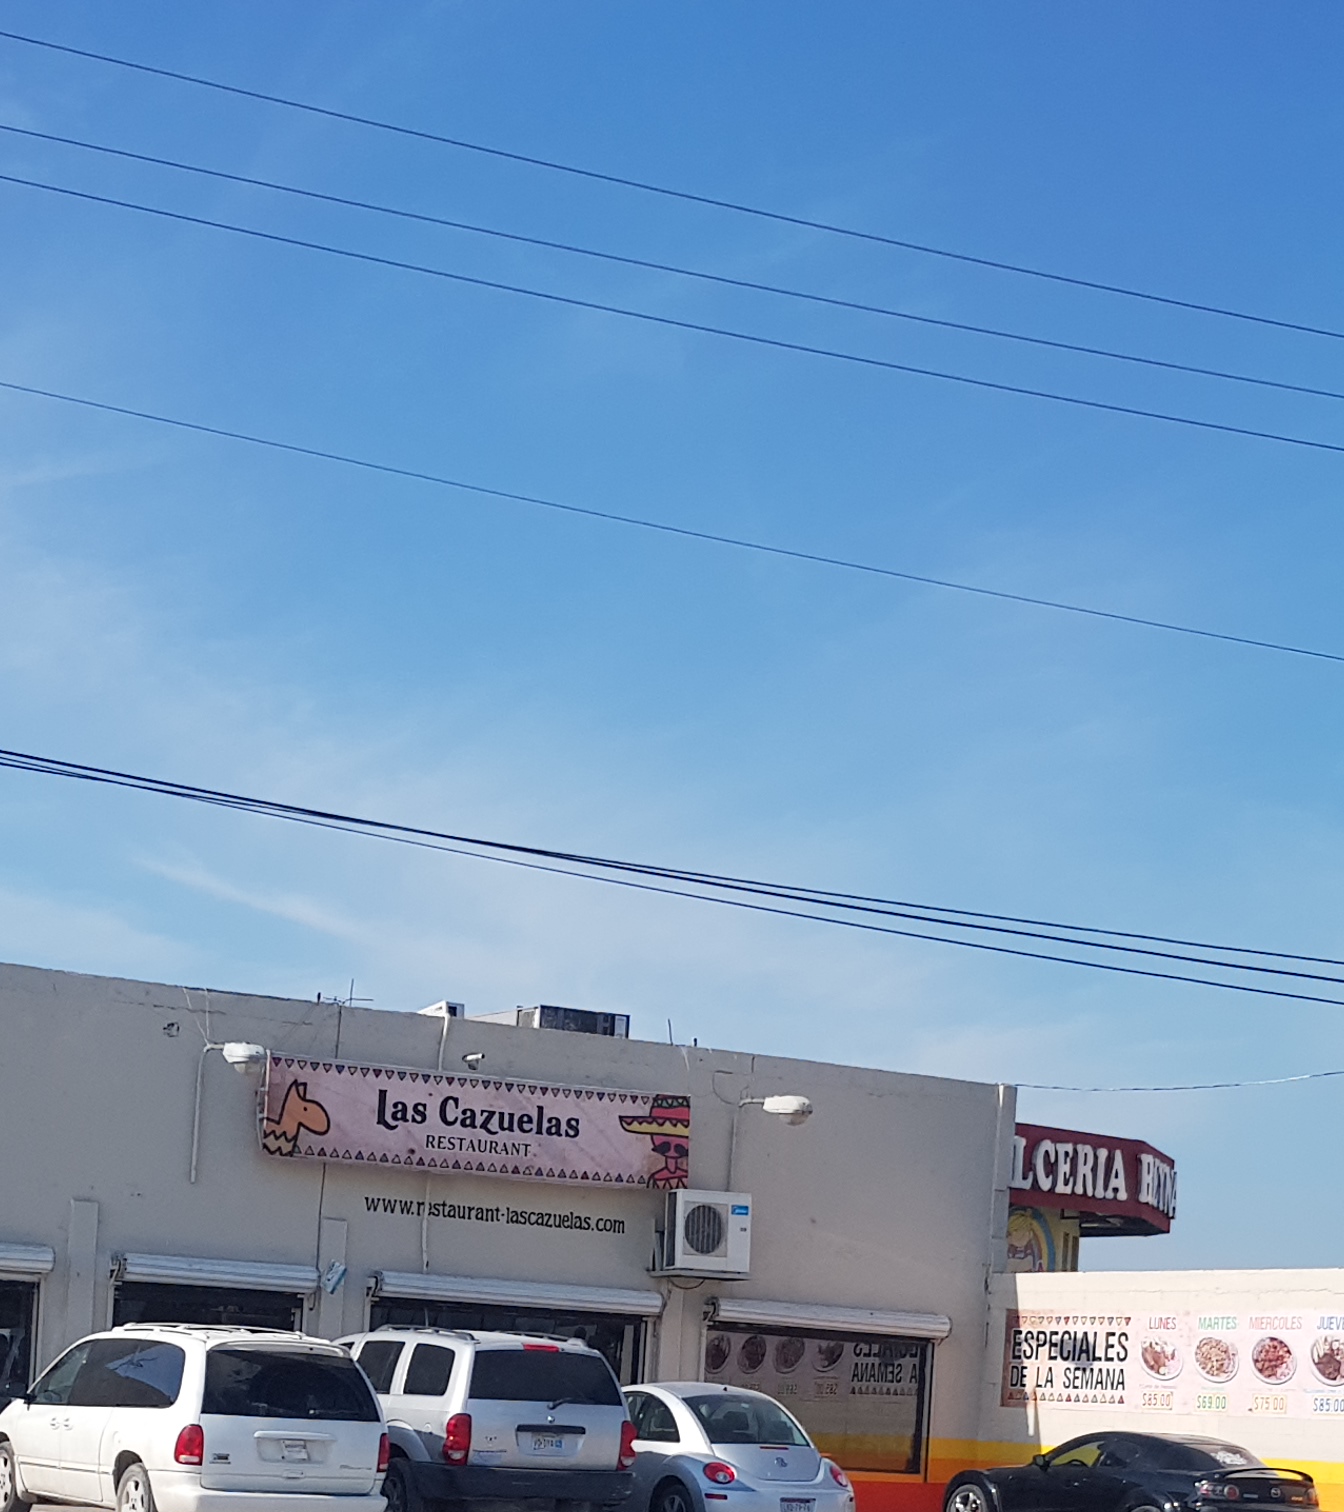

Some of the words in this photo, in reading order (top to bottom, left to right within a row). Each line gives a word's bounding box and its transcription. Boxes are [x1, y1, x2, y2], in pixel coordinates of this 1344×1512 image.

[376, 1089, 427, 1131] Las
[439, 1096, 580, 1138] Cazuelas
[425, 1135, 532, 1157] RESTAURANT
[1010, 1136, 1128, 1201] LCERIA
[1149, 1317, 1177, 1330] LUNES
[1198, 1316, 1237, 1330] MARTES
[1249, 1316, 1302, 1330] MIERCOLES
[1011, 1330, 1129, 1362] ESPECIALES
[1010, 1366, 1027, 1387] DE
[1036, 1367, 1054, 1388] LA
[1063, 1367, 1126, 1391] SEMANA
